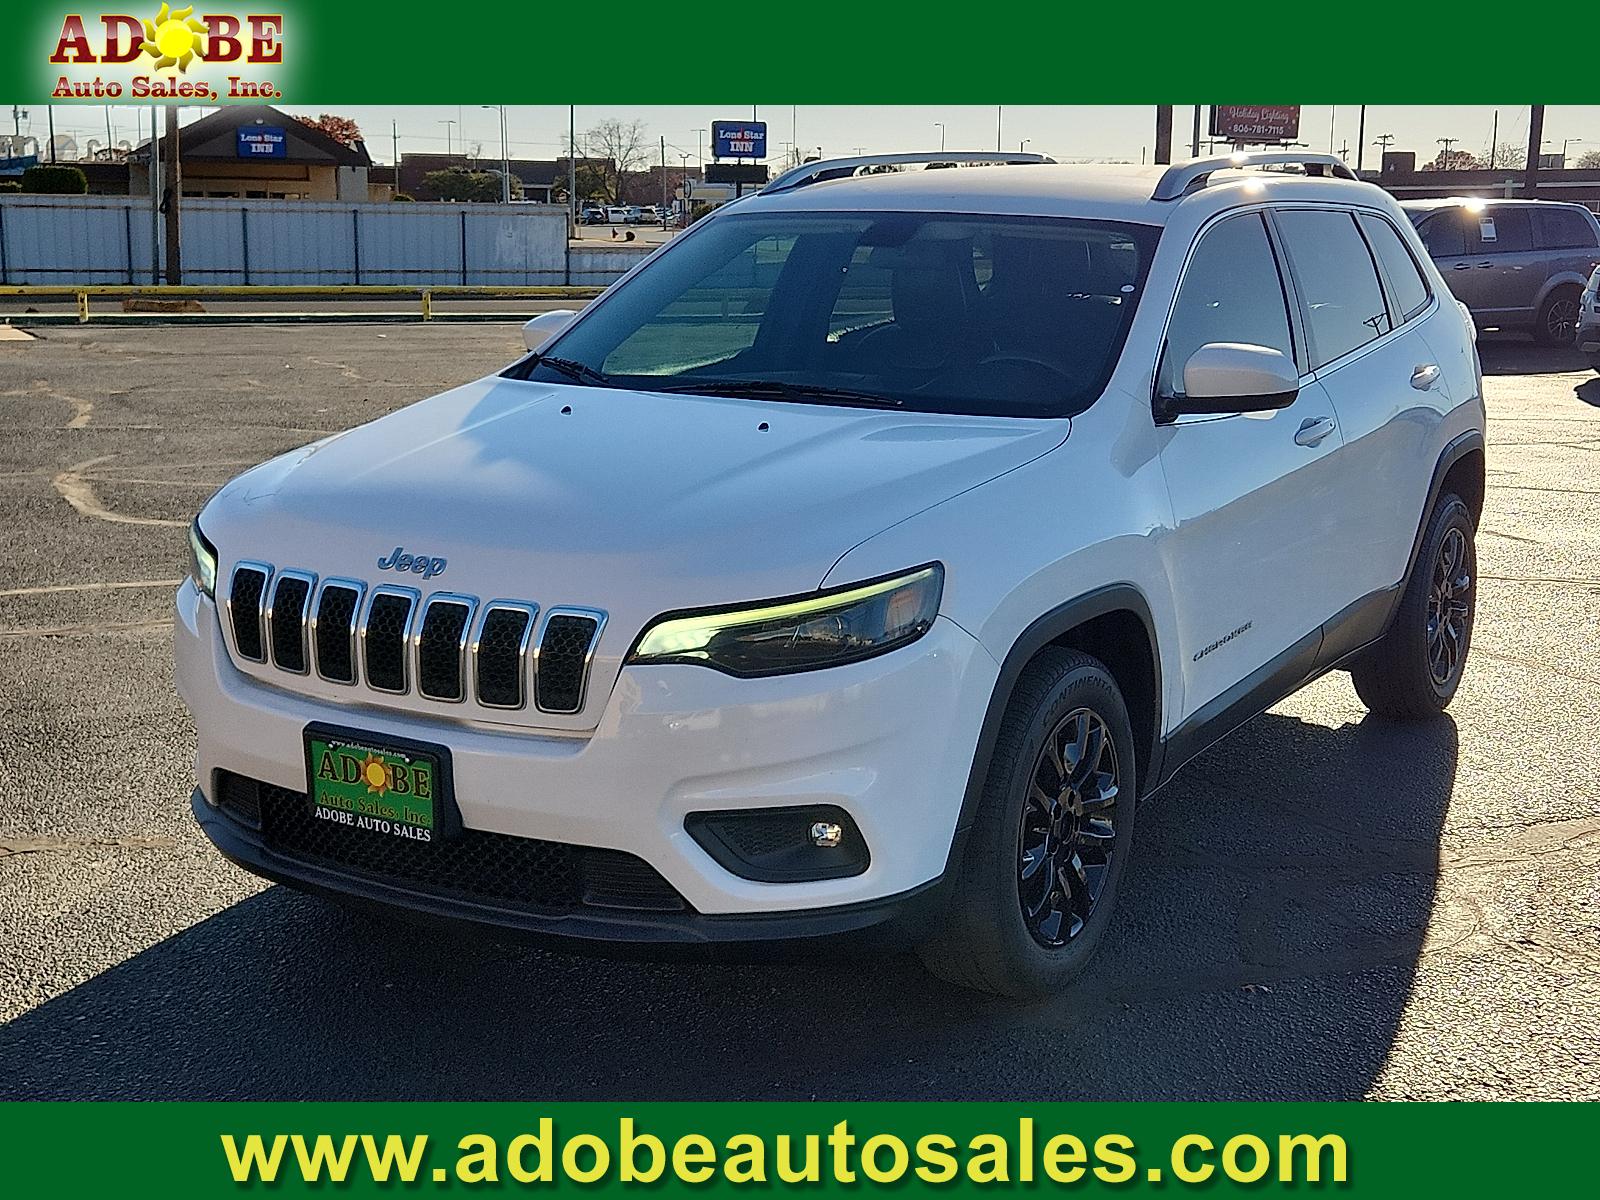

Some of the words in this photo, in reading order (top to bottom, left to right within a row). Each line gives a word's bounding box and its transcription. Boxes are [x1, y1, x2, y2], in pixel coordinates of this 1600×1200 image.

[1229, 105, 1260, 122] Holiday
[1261, 107, 1289, 124] Lighting
[719, 129, 742, 140] Lone
[744, 130, 764, 140] Star
[1233, 124, 1284, 134] 806-781-7115
[240, 133, 262, 142] Lone
[264, 134, 283, 143] Star
[251, 143, 274, 153] INN
[729, 141, 755, 152] INN
[377, 546, 448, 581] Jeep
[319, 790, 355, 810] Auto
[403, 806, 432, 826] Inc.
[315, 806, 355, 826] ADOBE
[357, 816, 391, 834] AUTO
[393, 823, 432, 842] SALES
